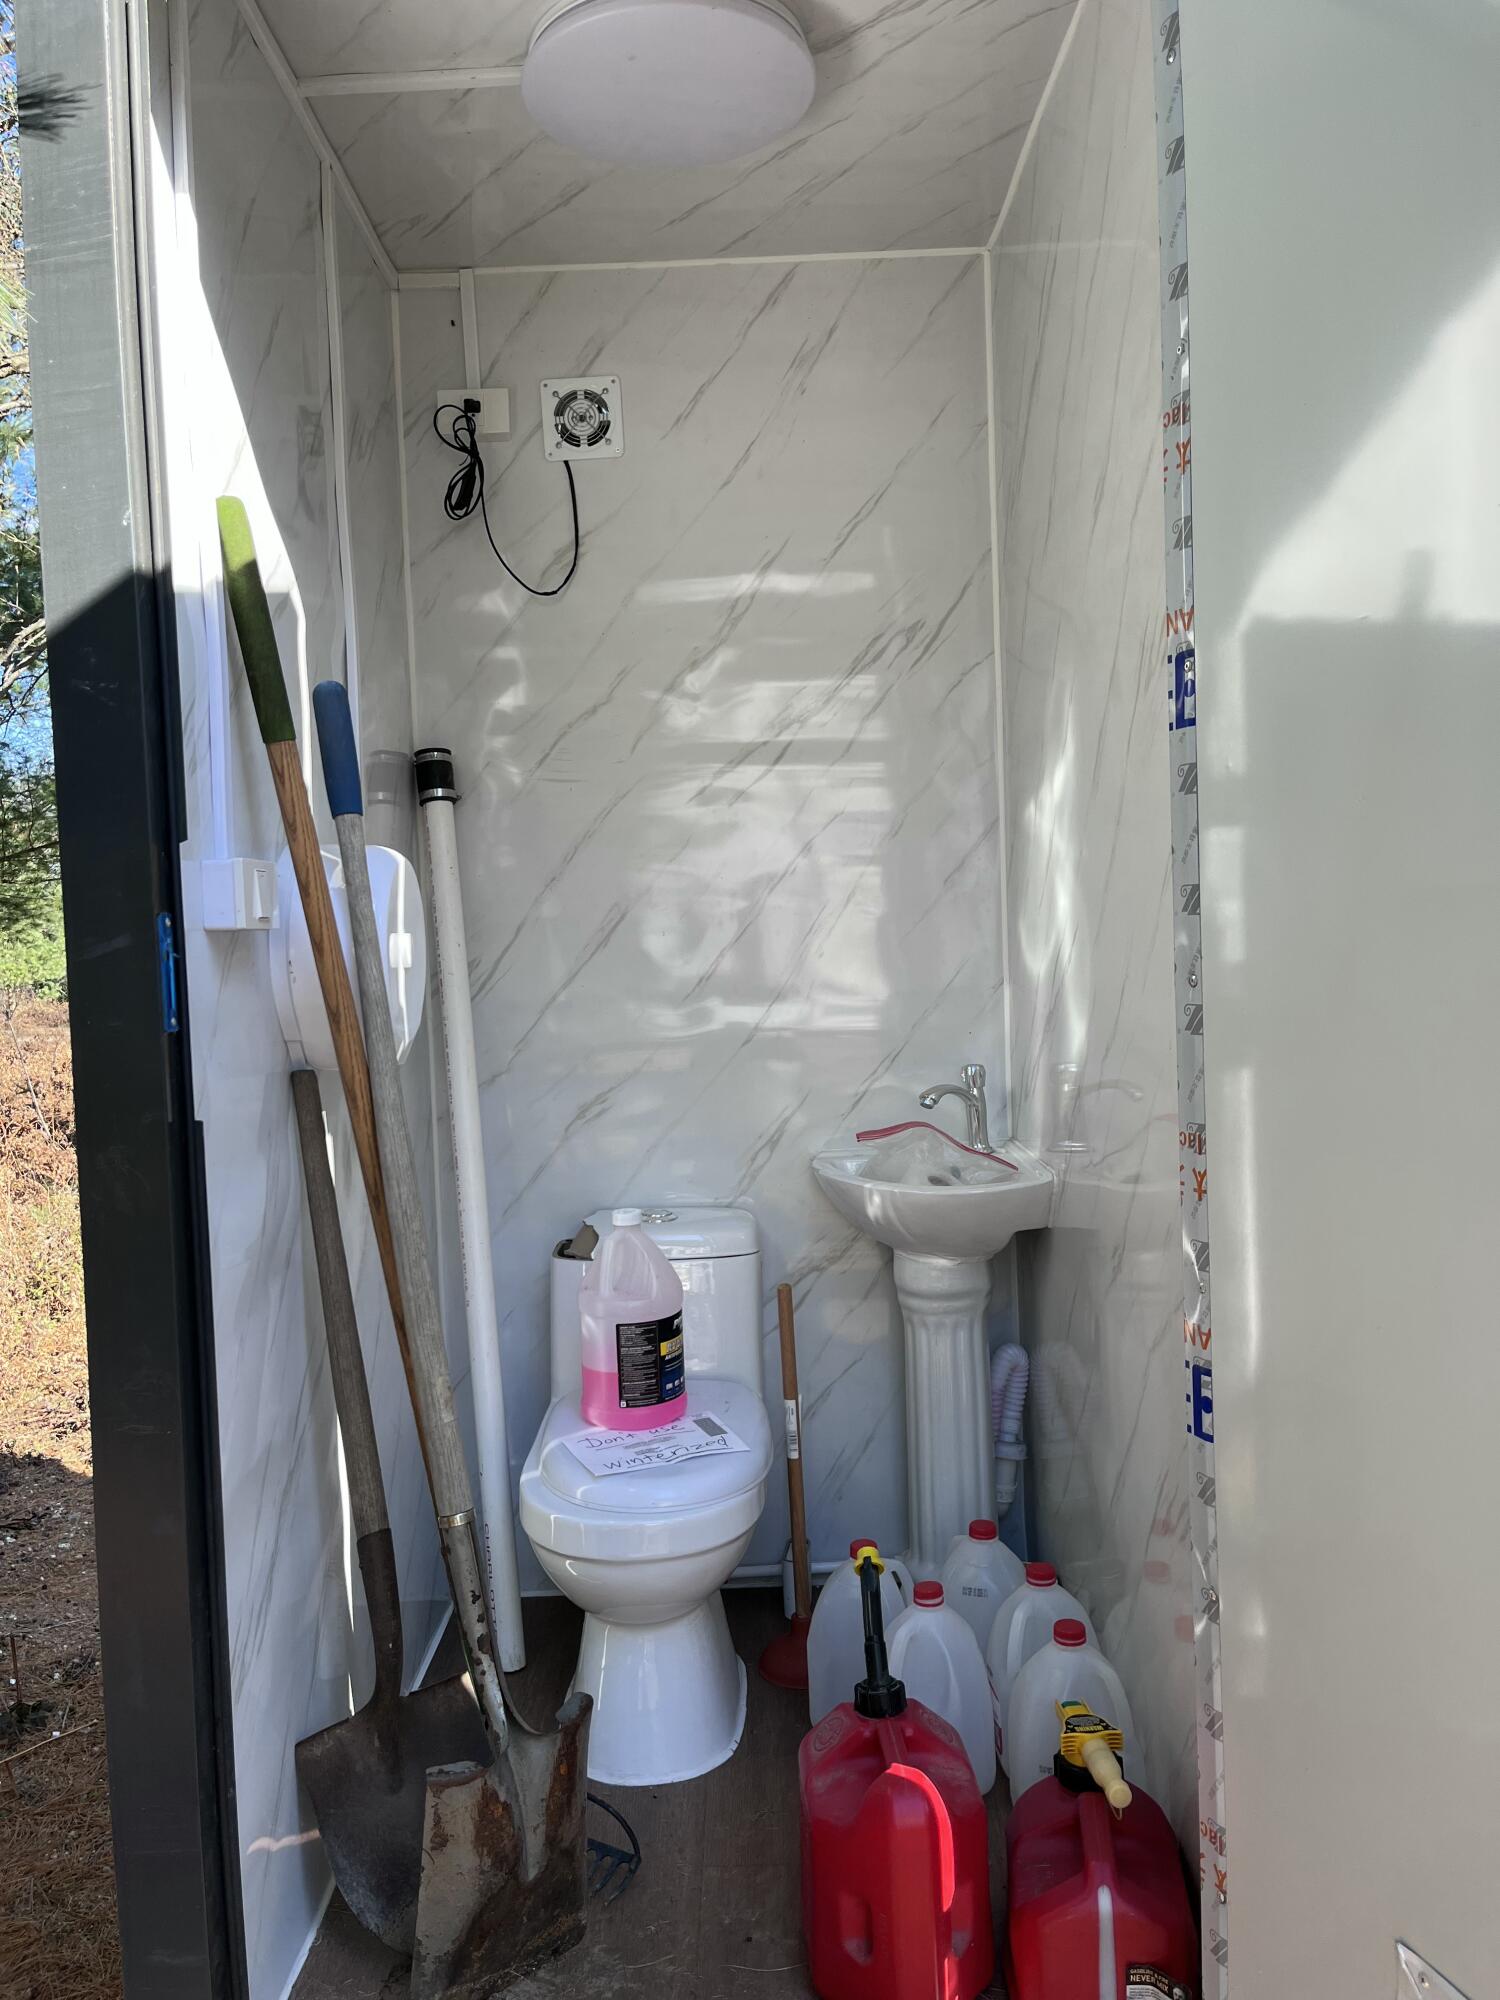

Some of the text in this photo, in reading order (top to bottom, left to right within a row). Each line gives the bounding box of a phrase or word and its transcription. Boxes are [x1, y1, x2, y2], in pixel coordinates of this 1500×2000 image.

[577, 1432, 638, 1449] Don't
[648, 1424, 686, 1436] use
[1130, 1974, 1156, 1985] NEVER
[1156, 1980, 1169, 1994] MIX
